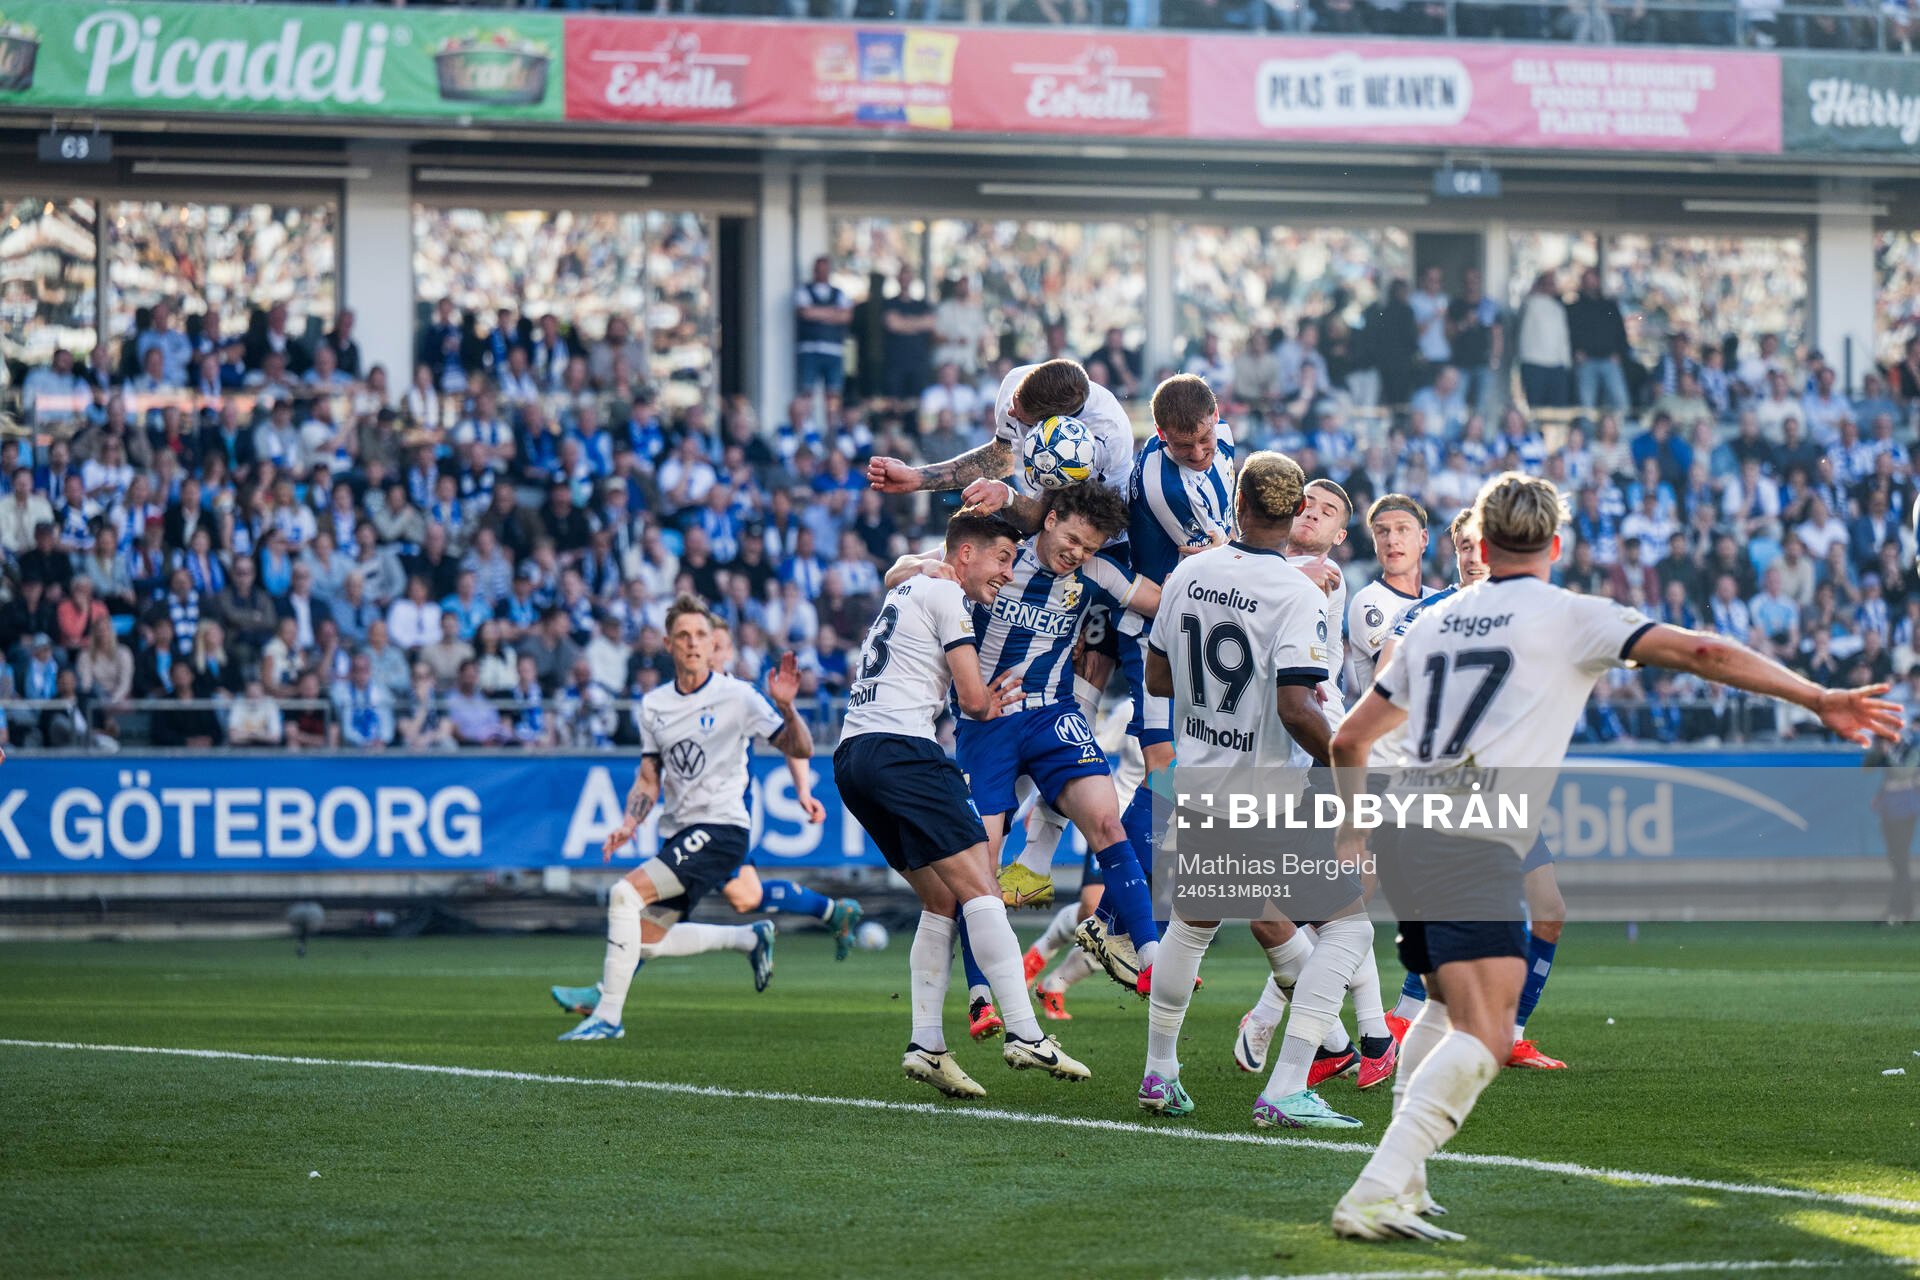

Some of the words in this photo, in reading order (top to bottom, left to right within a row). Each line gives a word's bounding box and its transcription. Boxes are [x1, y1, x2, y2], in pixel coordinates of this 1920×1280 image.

[74, 11, 387, 102] Picadeli
[605, 63, 738, 109] Estrella
[1026, 75, 1153, 120] Estrella
[1269, 74, 1323, 110] PEAS
[1363, 74, 1457, 110] HEAVEN
[984, 596, 1077, 636] ERNEKE
[1187, 579, 1258, 613] Cornelius
[1181, 613, 1254, 714] 19
[1419, 647, 1514, 762] 17
[1081, 744, 1097, 758] 23
[1186, 716, 1255, 752] tillmobil
[49, 769, 483, 860] GÖTEBORG
[683, 829, 711, 853] 5
